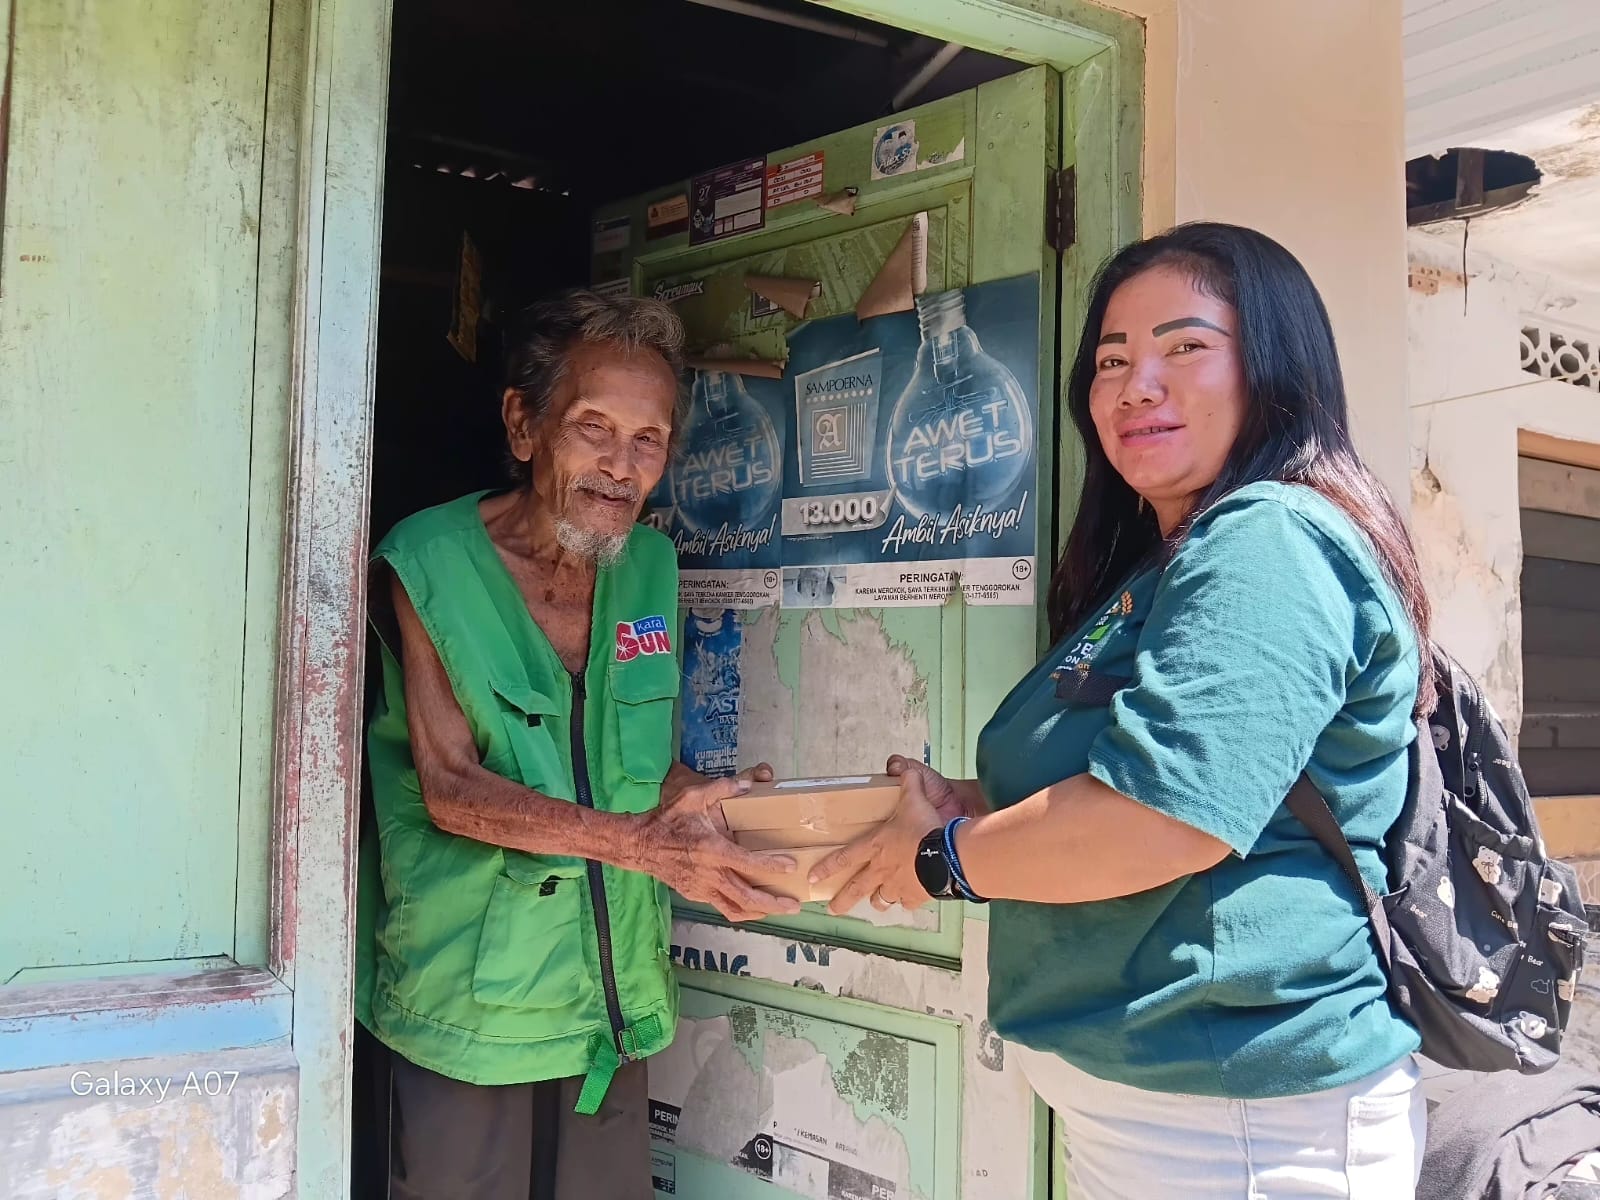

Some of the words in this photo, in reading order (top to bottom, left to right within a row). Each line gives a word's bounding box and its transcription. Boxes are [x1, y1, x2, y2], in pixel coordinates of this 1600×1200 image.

[806, 374, 873, 395] SAMPOERNA
[904, 399, 1009, 455] AWET
[682, 434, 764, 477] AWET
[894, 430, 1022, 483] TERUS
[676, 461, 772, 501] TERUS
[674, 529, 711, 556] Ambil
[708, 513, 777, 557] Asiknya!
[881, 513, 940, 554] Ambil
[940, 490, 1028, 545] Asiknya!
[637, 619, 664, 631] kara
[1410, 903, 1428, 919] Bear
[1527, 955, 1544, 967] Bear
